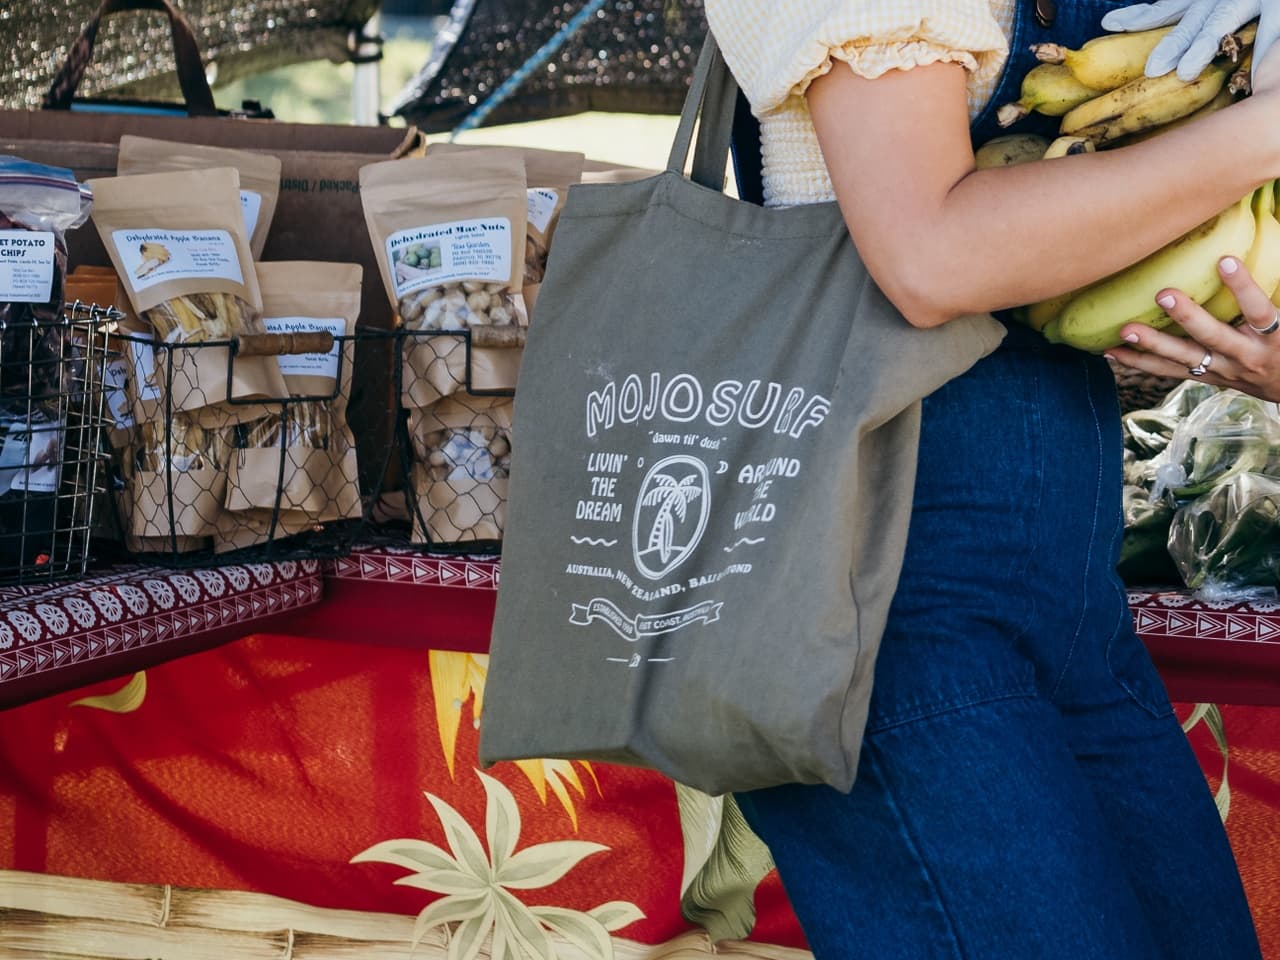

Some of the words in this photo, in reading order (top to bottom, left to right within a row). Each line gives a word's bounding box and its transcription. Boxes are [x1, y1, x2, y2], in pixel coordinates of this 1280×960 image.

[11, 239, 46, 247] POTATO
[390, 227, 453, 248] Dehydrated
[480, 223, 505, 231] Nuts
[1, 249, 26, 257] CHIPS
[587, 453, 628, 473] LIVIN'
[591, 477, 617, 497] THE
[575, 500, 622, 523] DREAM
[566, 563, 615, 580] AUSTRALIA,
[615, 569, 634, 590] NEW
